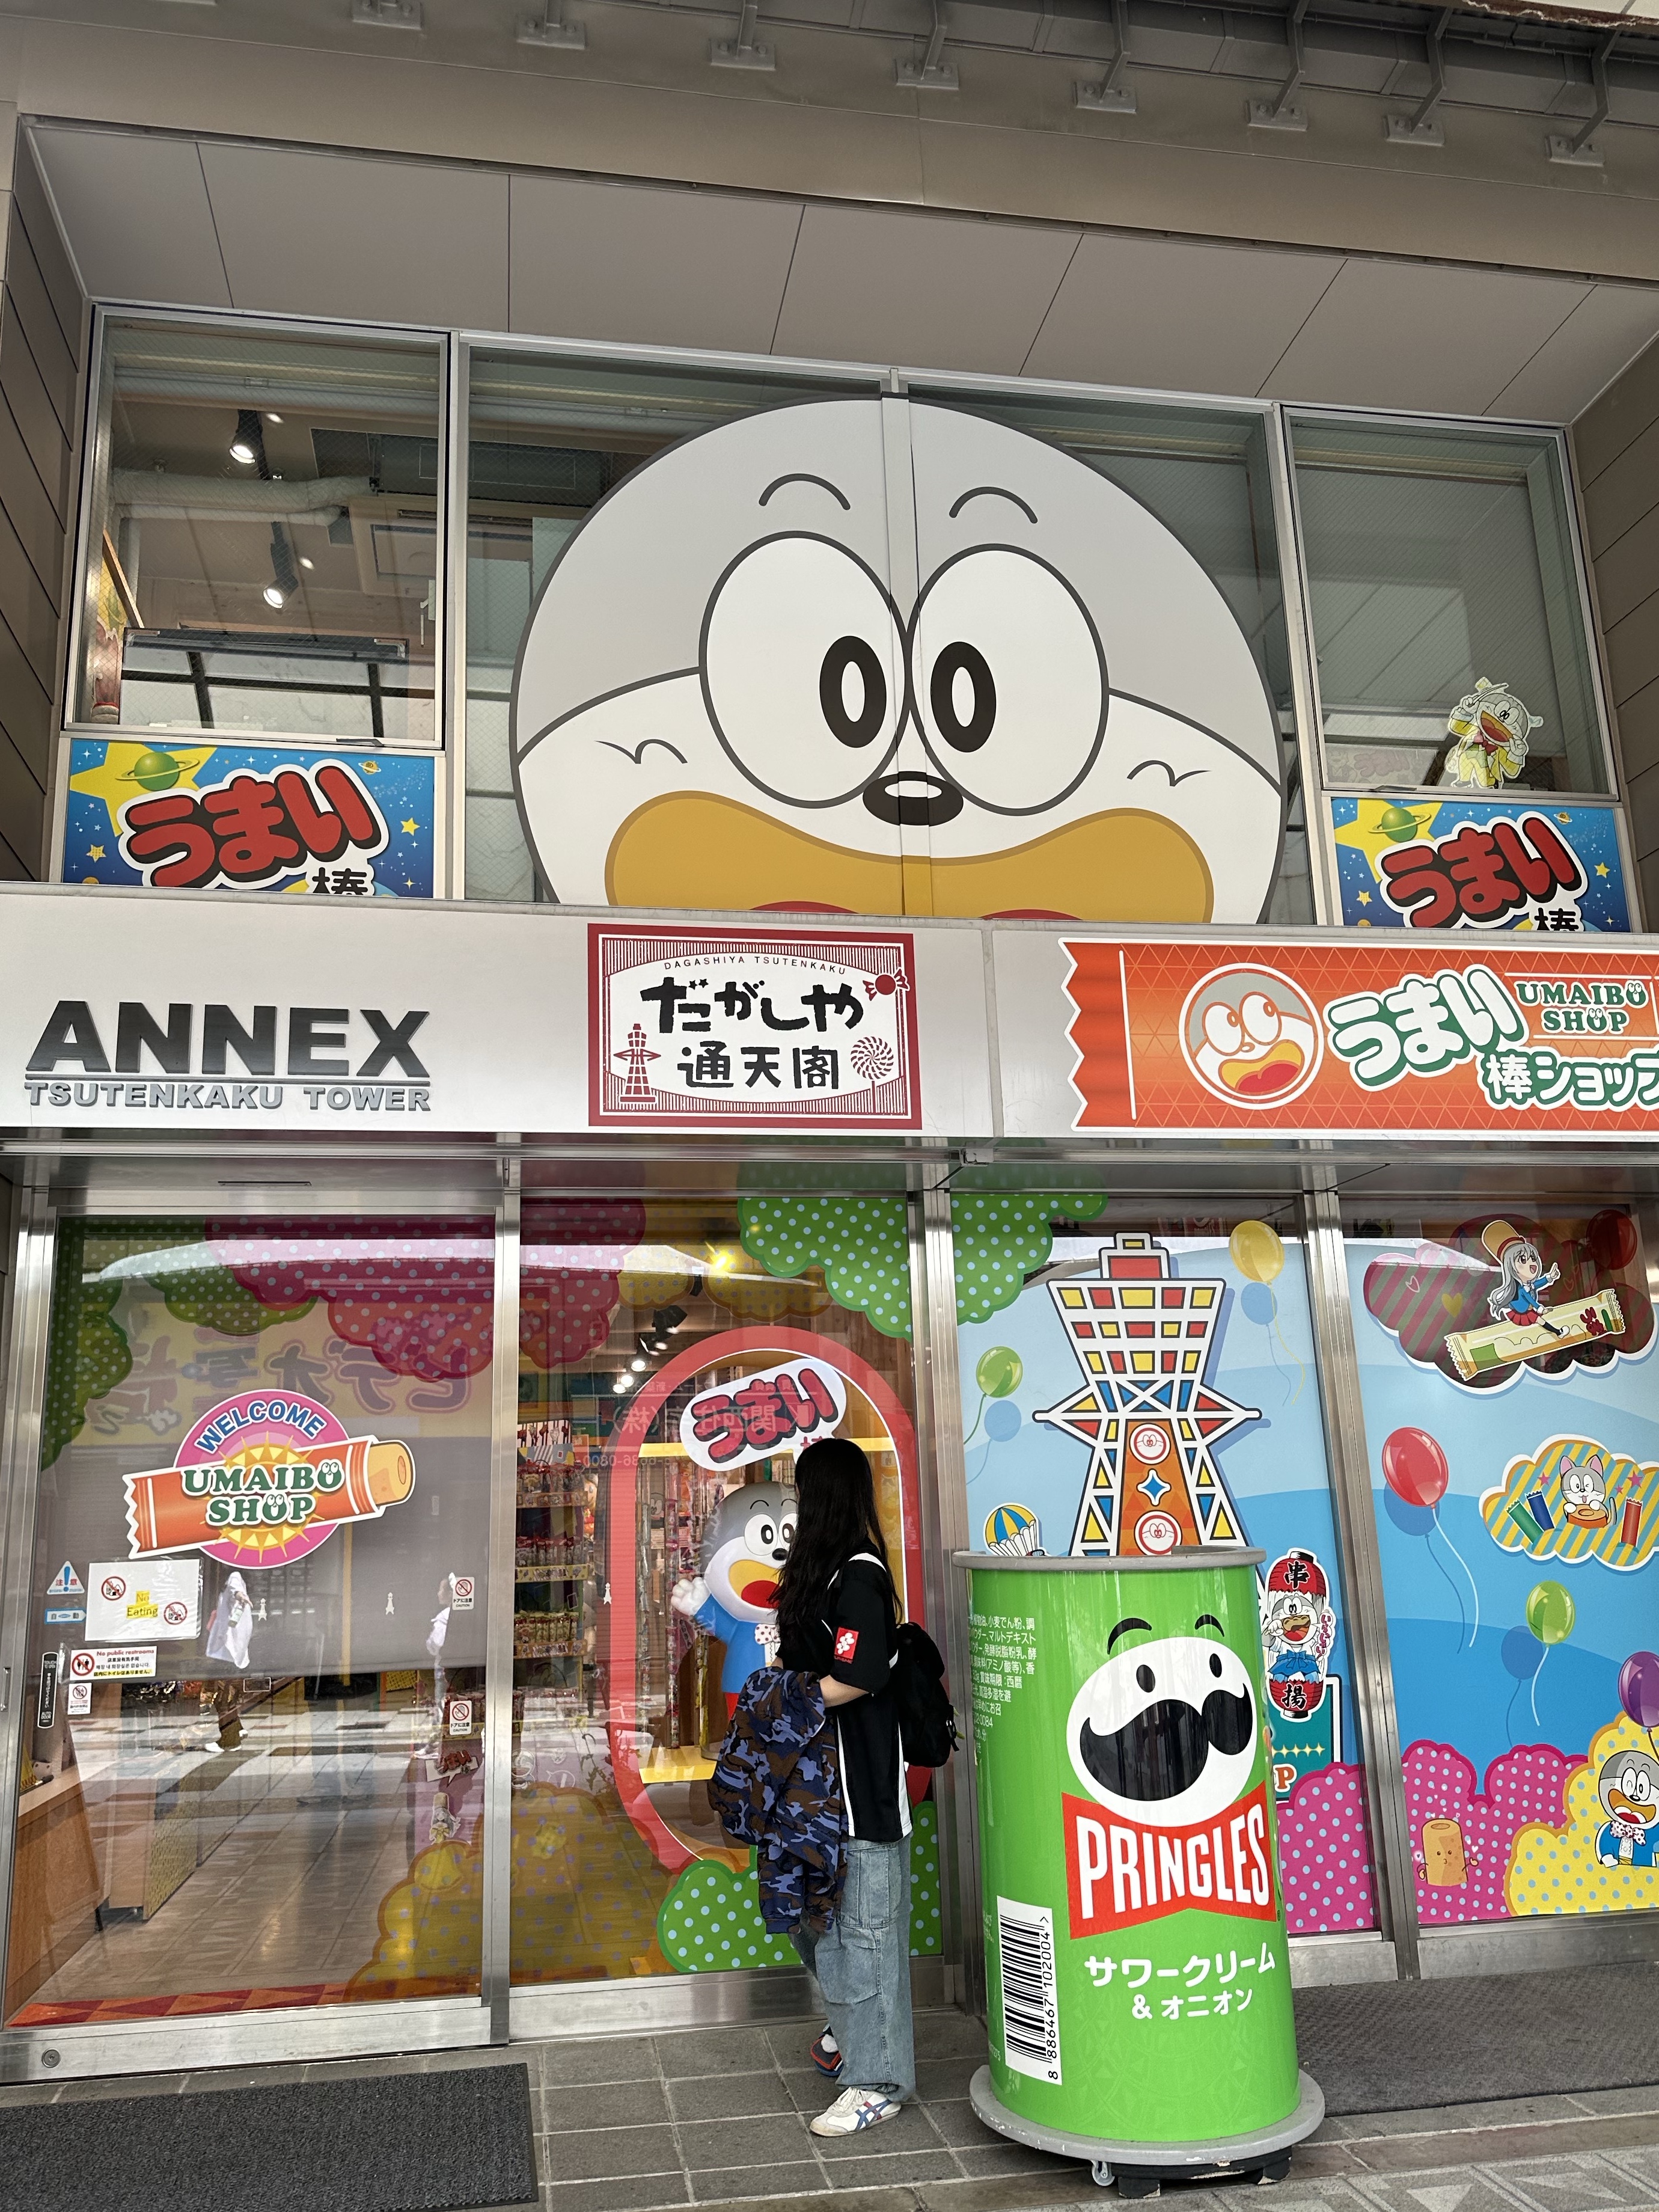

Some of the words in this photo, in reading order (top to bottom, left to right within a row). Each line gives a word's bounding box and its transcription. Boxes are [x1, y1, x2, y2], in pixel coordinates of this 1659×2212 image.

[126, 765, 380, 889] うまい
[1381, 818, 1583, 928] うまい
[664, 956, 745, 970] DAGASHIYA
[754, 956, 846, 975] TSUTENKAKU
[640, 977, 864, 1033] だがしや
[1330, 970, 1525, 1086] うまい
[1543, 1008, 1627, 1032] SHOP
[26, 1000, 430, 1078] ANNEX
[677, 1041, 839, 1089] 通天閣
[25, 1081, 283, 1110] TSUTENKAKU
[304, 1085, 430, 1111] TOWER
[196, 1401, 326, 1453] WELCOME
[692, 1368, 838, 1463] うまい
[207, 1494, 316, 1525] SHOP
[136, 1593, 150, 1602] No
[1284, 1560, 1309, 1589] 串
[127, 1607, 158, 1618] Eating
[1281, 1684, 1307, 1709] 揚
[1075, 1803, 1269, 1920] PRINGLES
[1040, 1932, 1054, 1988] 102004
[1084, 1943, 1276, 1988] サワークリーム
[1133, 1996, 1153, 2020] &
[1161, 1988, 1254, 2021] オニオン
[1043, 1999, 1059, 2059] 886467
[1048, 2070, 1059, 2080] 8
